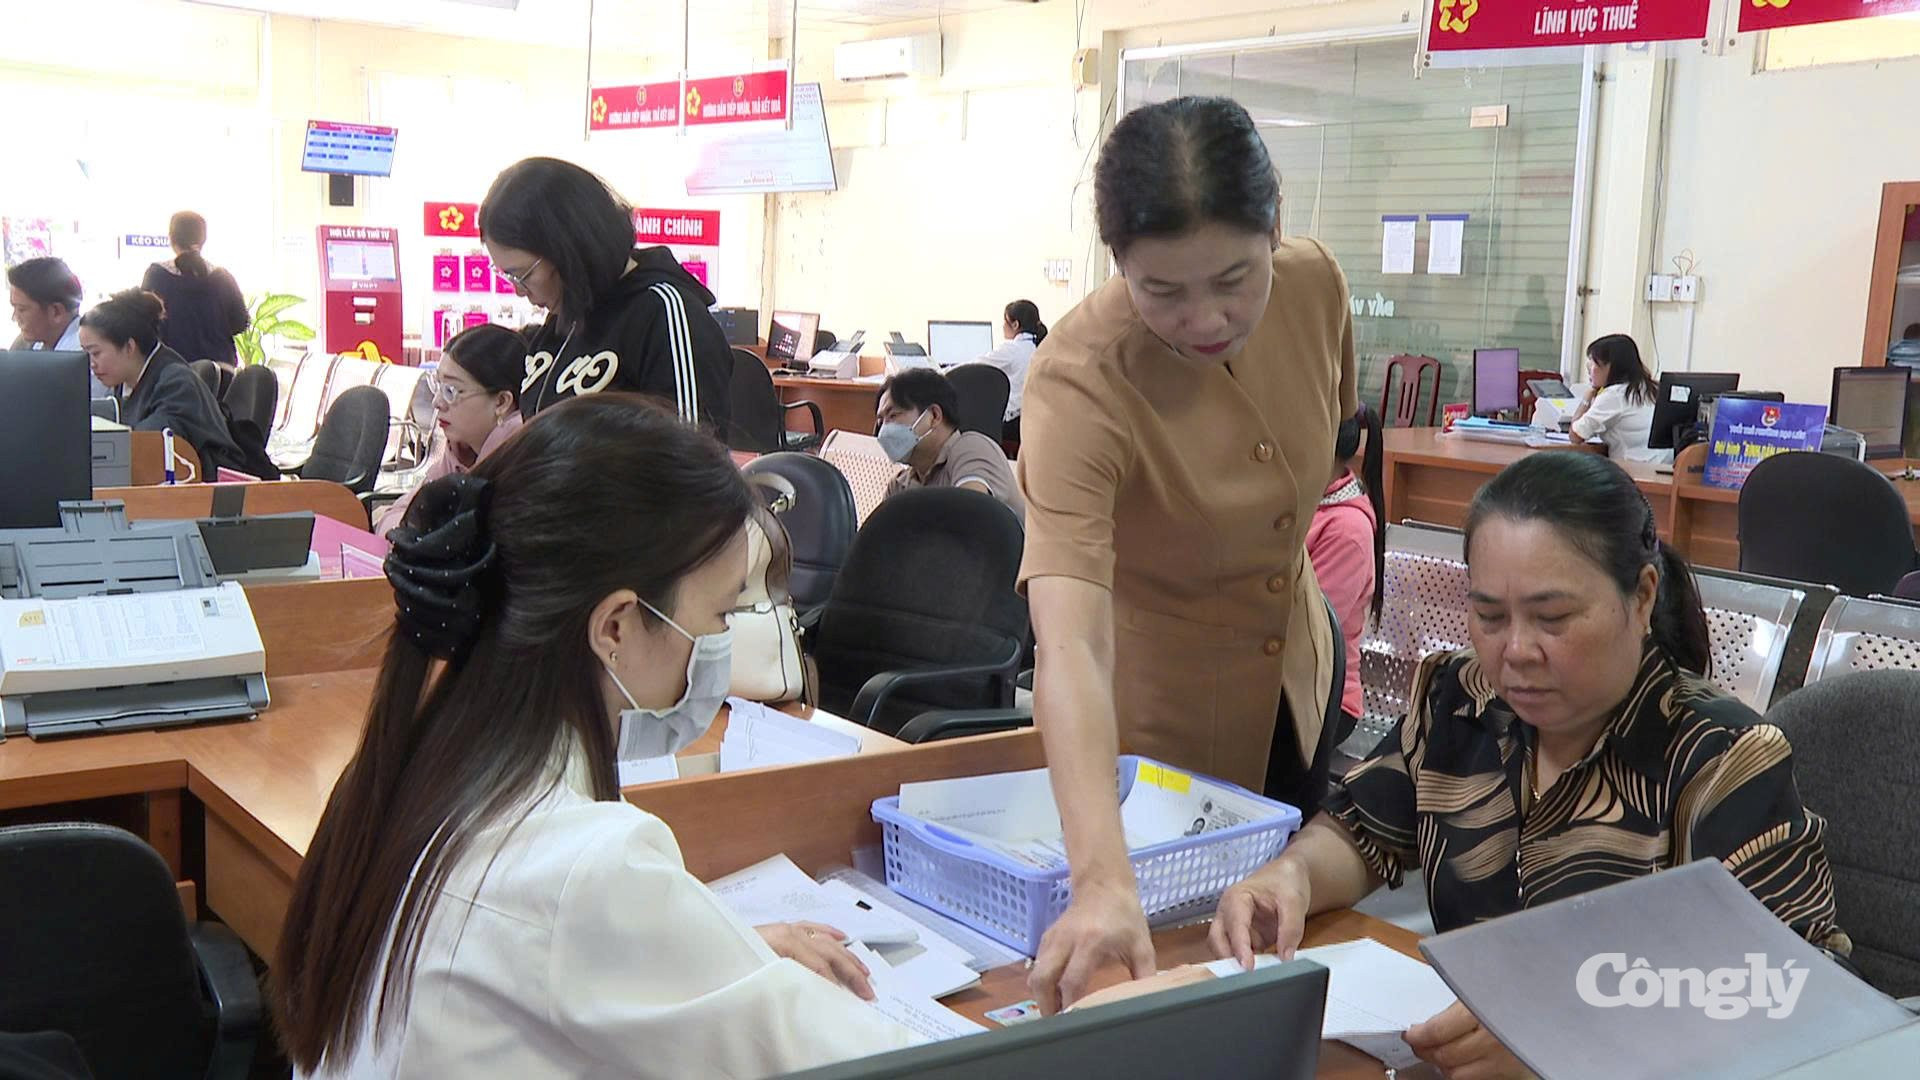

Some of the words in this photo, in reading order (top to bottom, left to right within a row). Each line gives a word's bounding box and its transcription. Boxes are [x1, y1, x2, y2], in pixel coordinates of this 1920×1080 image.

[1533, 6, 1568, 35] LĨNH
[1570, 5, 1599, 38] VỰC
[1601, 0, 1639, 32] THUẾ
[636, 214, 661, 234] ÀNH
[663, 213, 703, 237] CHÍNH
